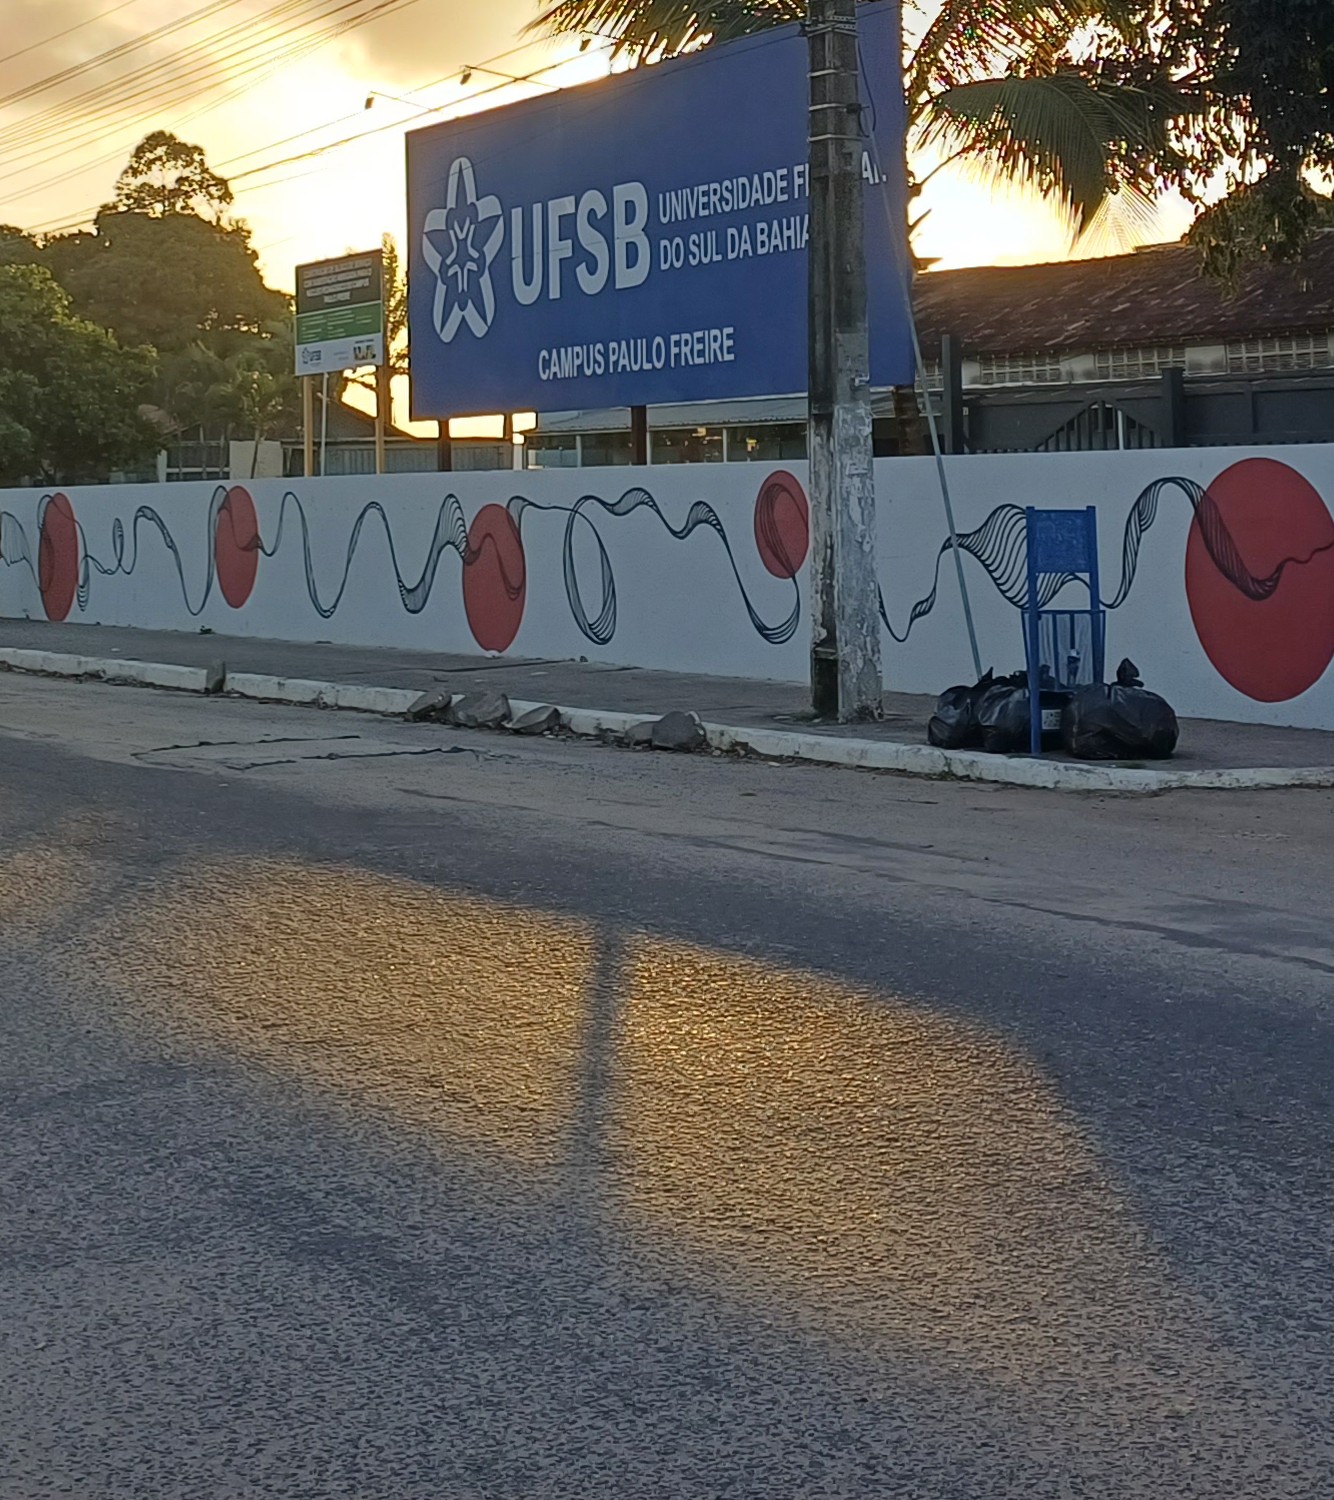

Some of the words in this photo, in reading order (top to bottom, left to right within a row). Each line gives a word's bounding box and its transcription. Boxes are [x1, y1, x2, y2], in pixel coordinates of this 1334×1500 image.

[659, 168, 785, 223] UNIVERSIDADE
[511, 182, 650, 305] UFSB
[660, 237, 685, 270] DO
[688, 231, 722, 266] SUL
[727, 225, 753, 260] DA
[539, 343, 605, 380] CAMPUS
[609, 336, 665, 373] PAULO
[670, 327, 734, 368] FREIRE
